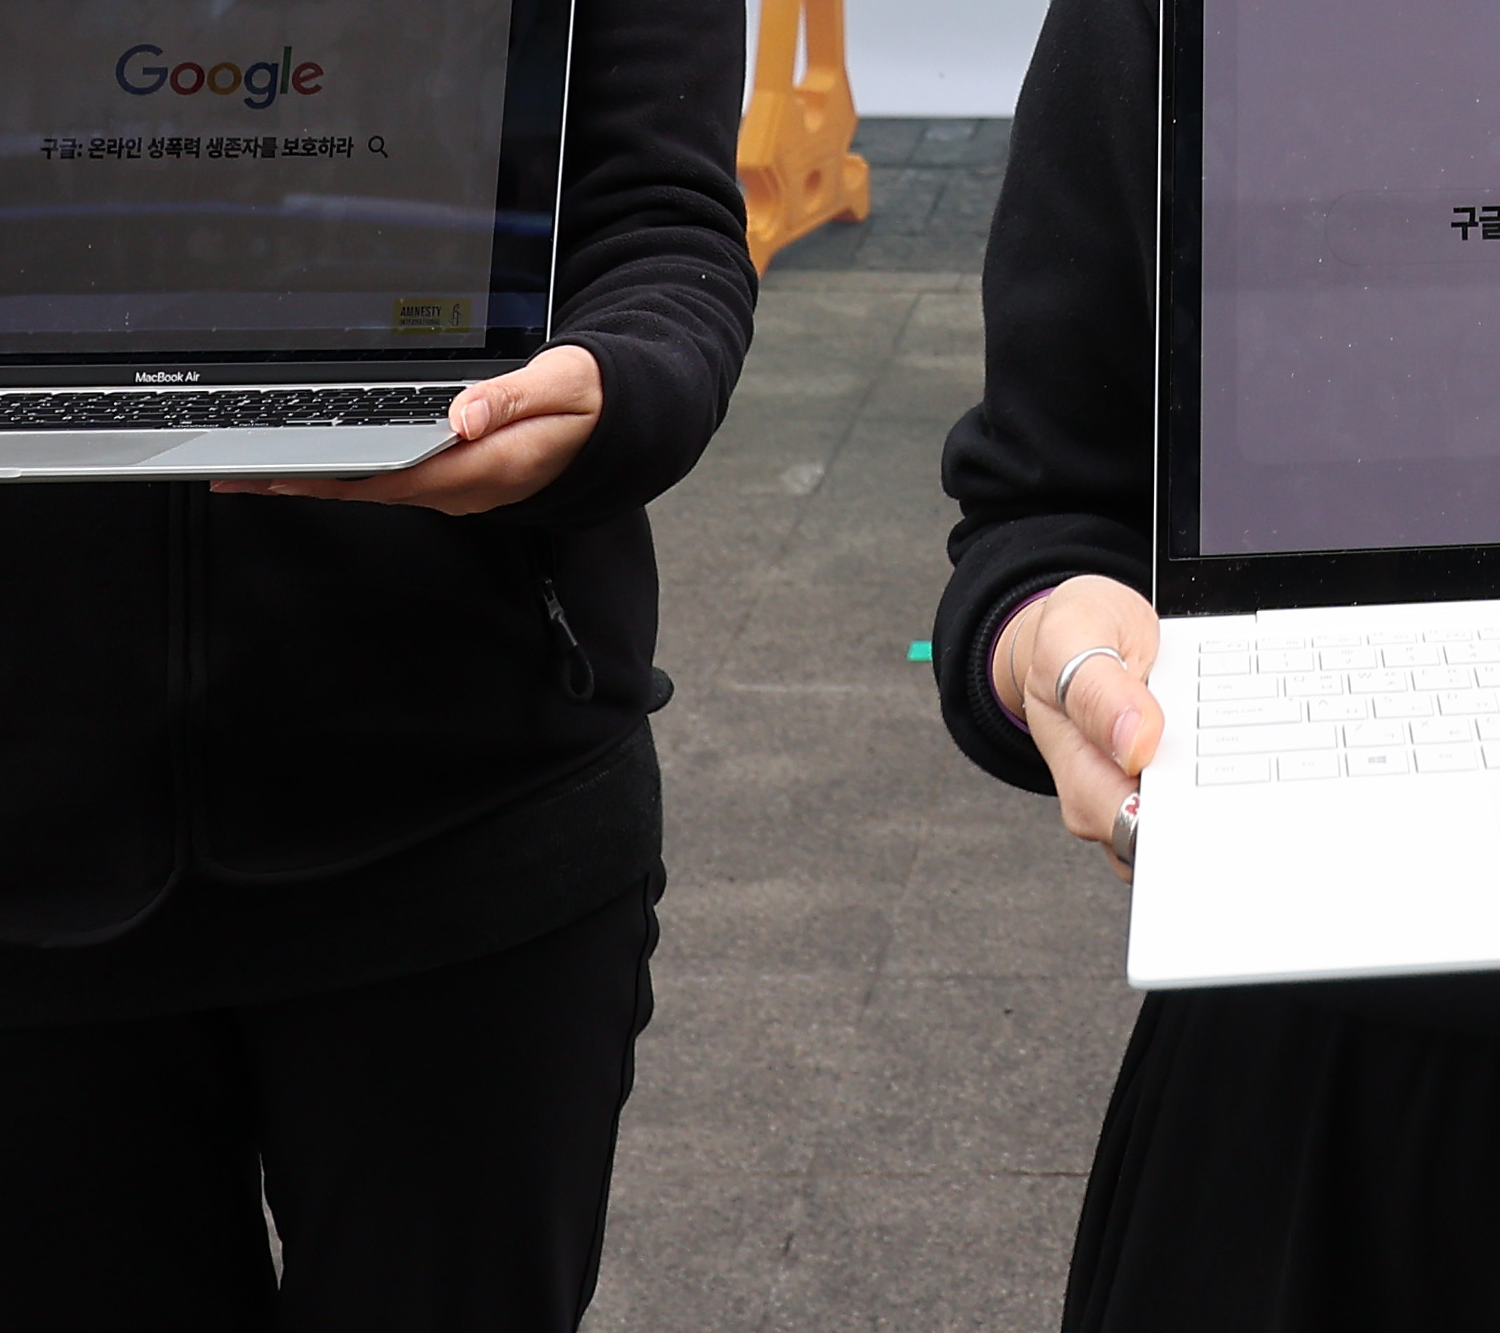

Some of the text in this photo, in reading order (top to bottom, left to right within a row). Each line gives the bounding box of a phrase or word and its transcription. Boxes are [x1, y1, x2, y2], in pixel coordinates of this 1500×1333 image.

[115, 43, 325, 110] Google
[40, 135, 354, 160] 구글: 온라인 성폭력 생존자를 보호하라
[135, 371, 201, 383] MacBook Air
